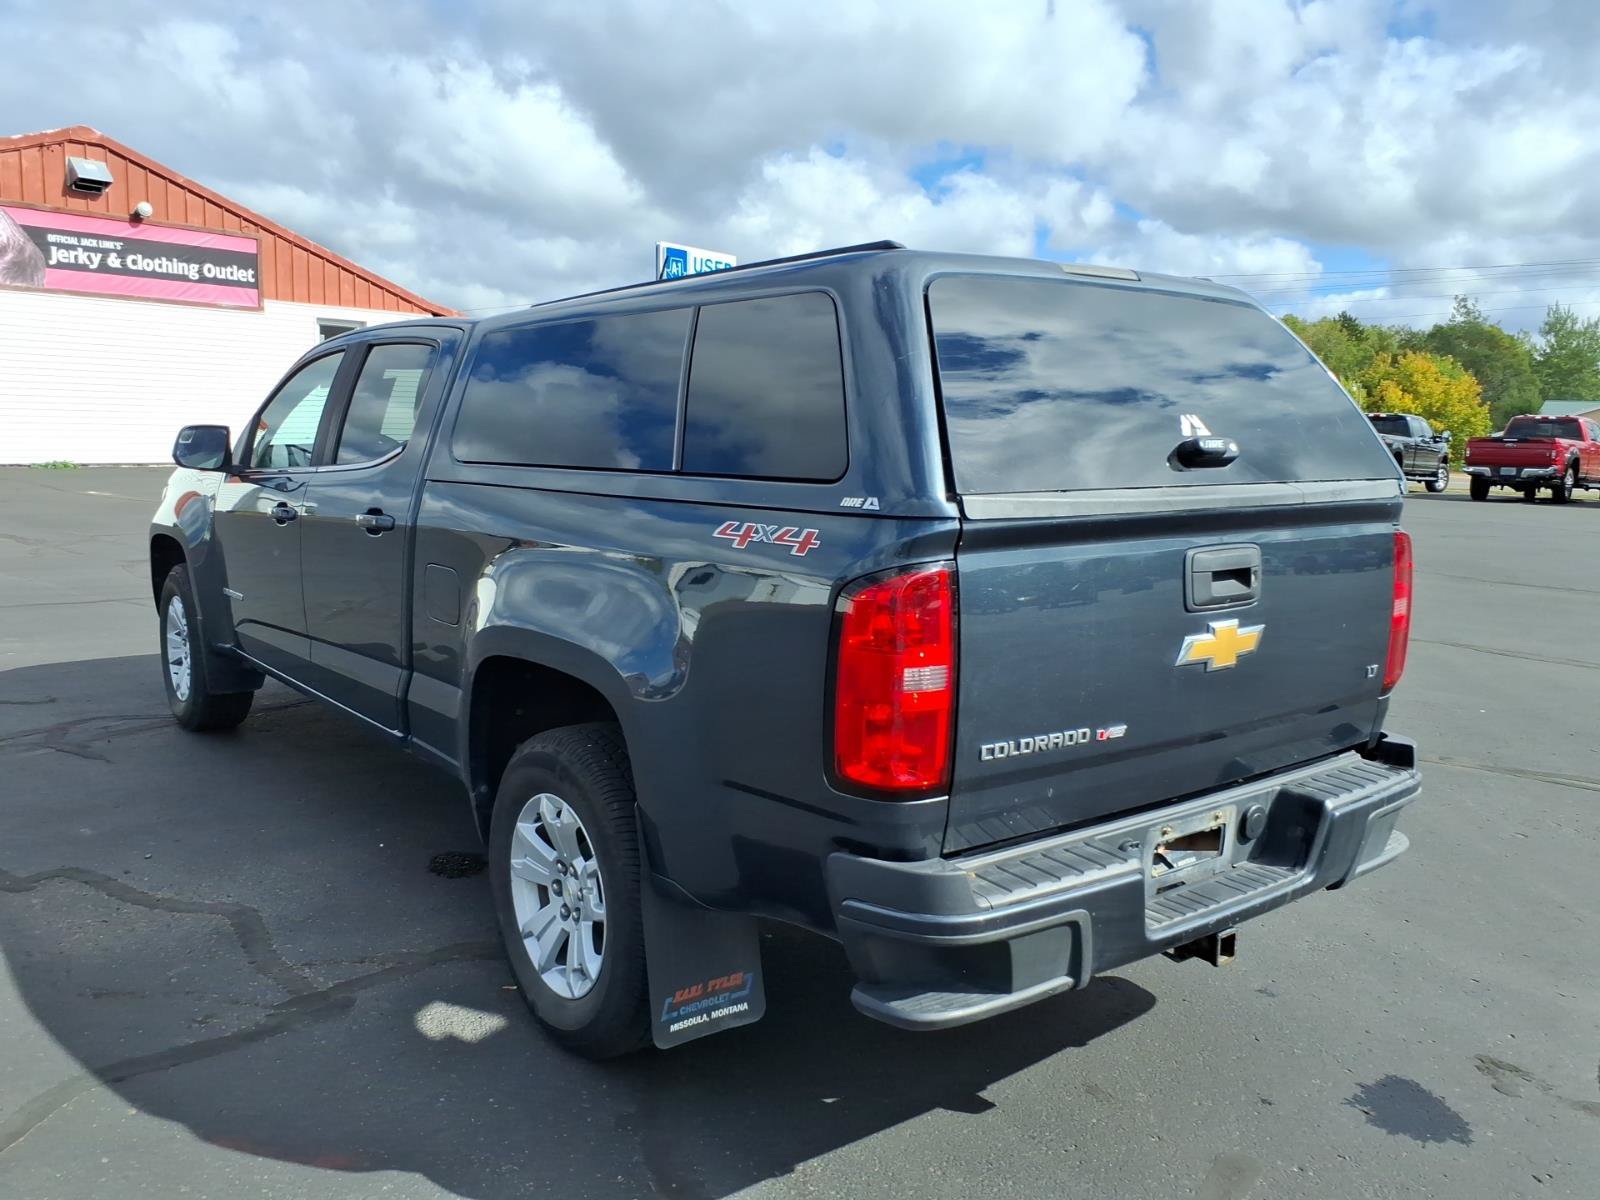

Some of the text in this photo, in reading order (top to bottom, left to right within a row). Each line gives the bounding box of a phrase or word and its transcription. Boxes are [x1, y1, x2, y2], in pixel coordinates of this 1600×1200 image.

[47, 233, 79, 246] OFFICIAL
[80, 237, 98, 247] JACK
[48, 245, 256, 283] Jerky & Clothing Outlet
[980, 728, 1091, 761] COLORADO
[669, 1002, 749, 1033] MISSOULA, MONTANA
[679, 992, 730, 1016] CHEVROLET
